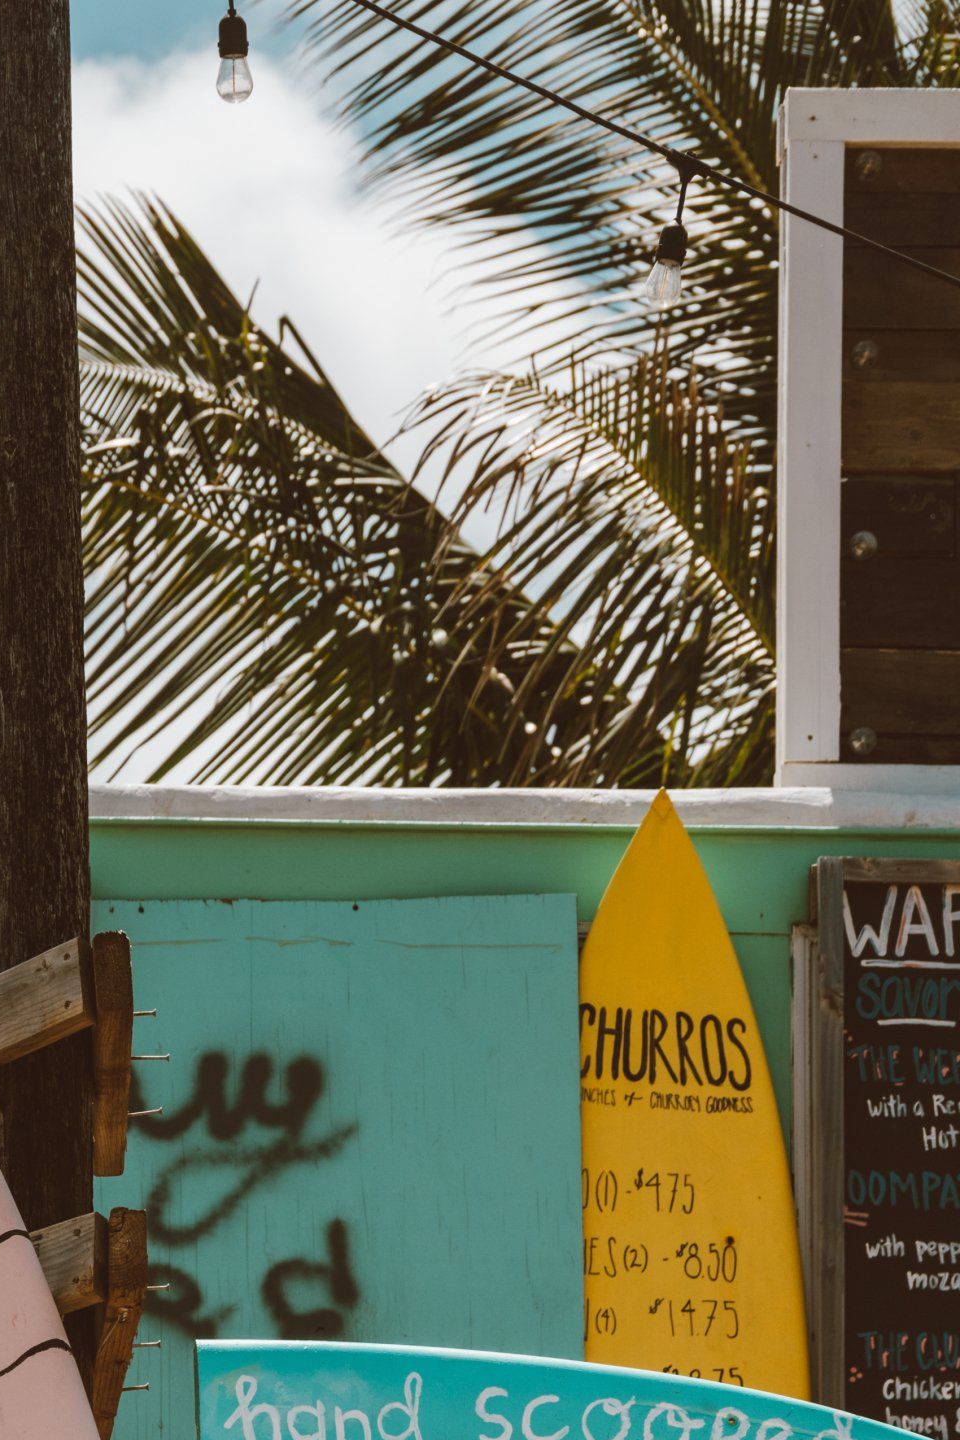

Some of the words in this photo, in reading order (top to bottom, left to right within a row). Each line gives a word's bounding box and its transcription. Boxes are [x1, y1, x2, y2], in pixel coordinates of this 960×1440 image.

[580, 1003, 752, 1091] CHURROS
[847, 1044, 907, 1083] THE
[866, 1093, 908, 1118] with
[913, 1100, 925, 1118] a
[931, 1093, 960, 1118] Re
[847, 1168, 960, 1211] OOMPA
[623, 1243, 648, 1273] (2)
[676, 1241, 737, 1283] $8.50
[865, 1233, 905, 1259] with
[857, 1330, 909, 1371] THE
